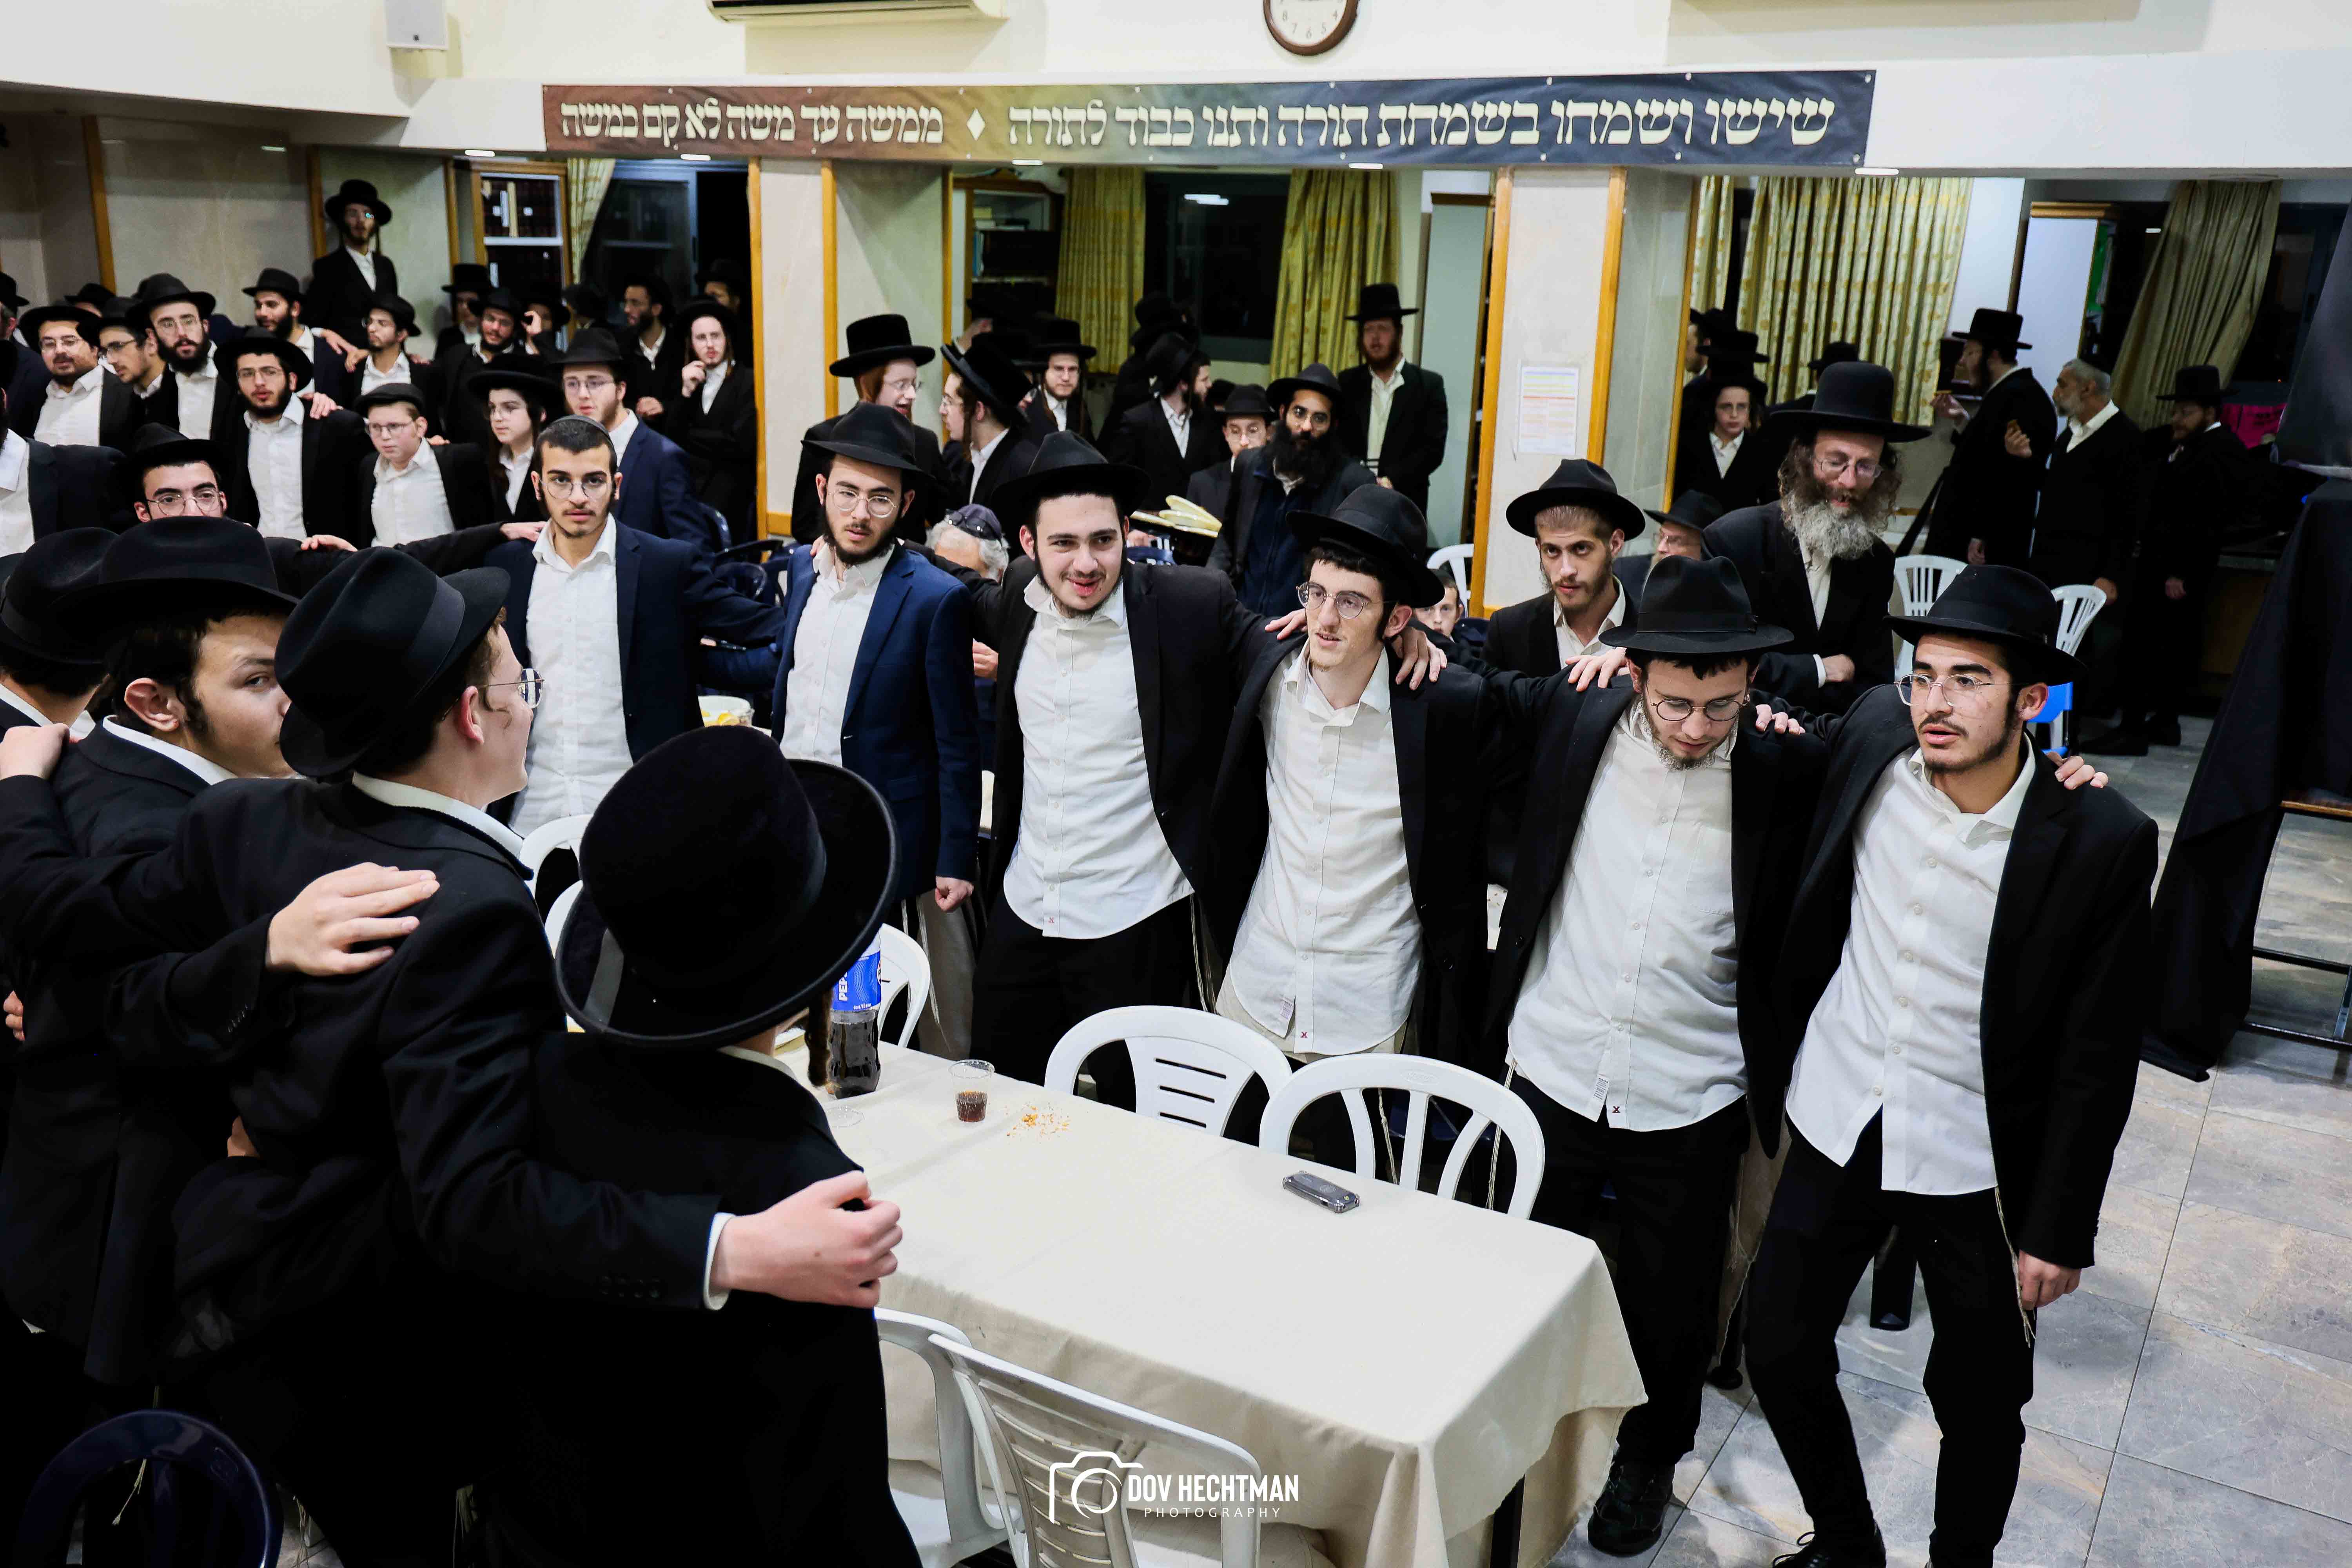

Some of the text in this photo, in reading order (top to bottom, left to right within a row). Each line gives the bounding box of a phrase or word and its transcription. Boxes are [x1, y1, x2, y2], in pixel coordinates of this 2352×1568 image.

[561, 97, 1835, 147] שישו ושמחו בשמחת תורה ותנו כבוד לתורה ממשה עד משה לא קם כמשה
[838, 972, 848, 1001] PEP
